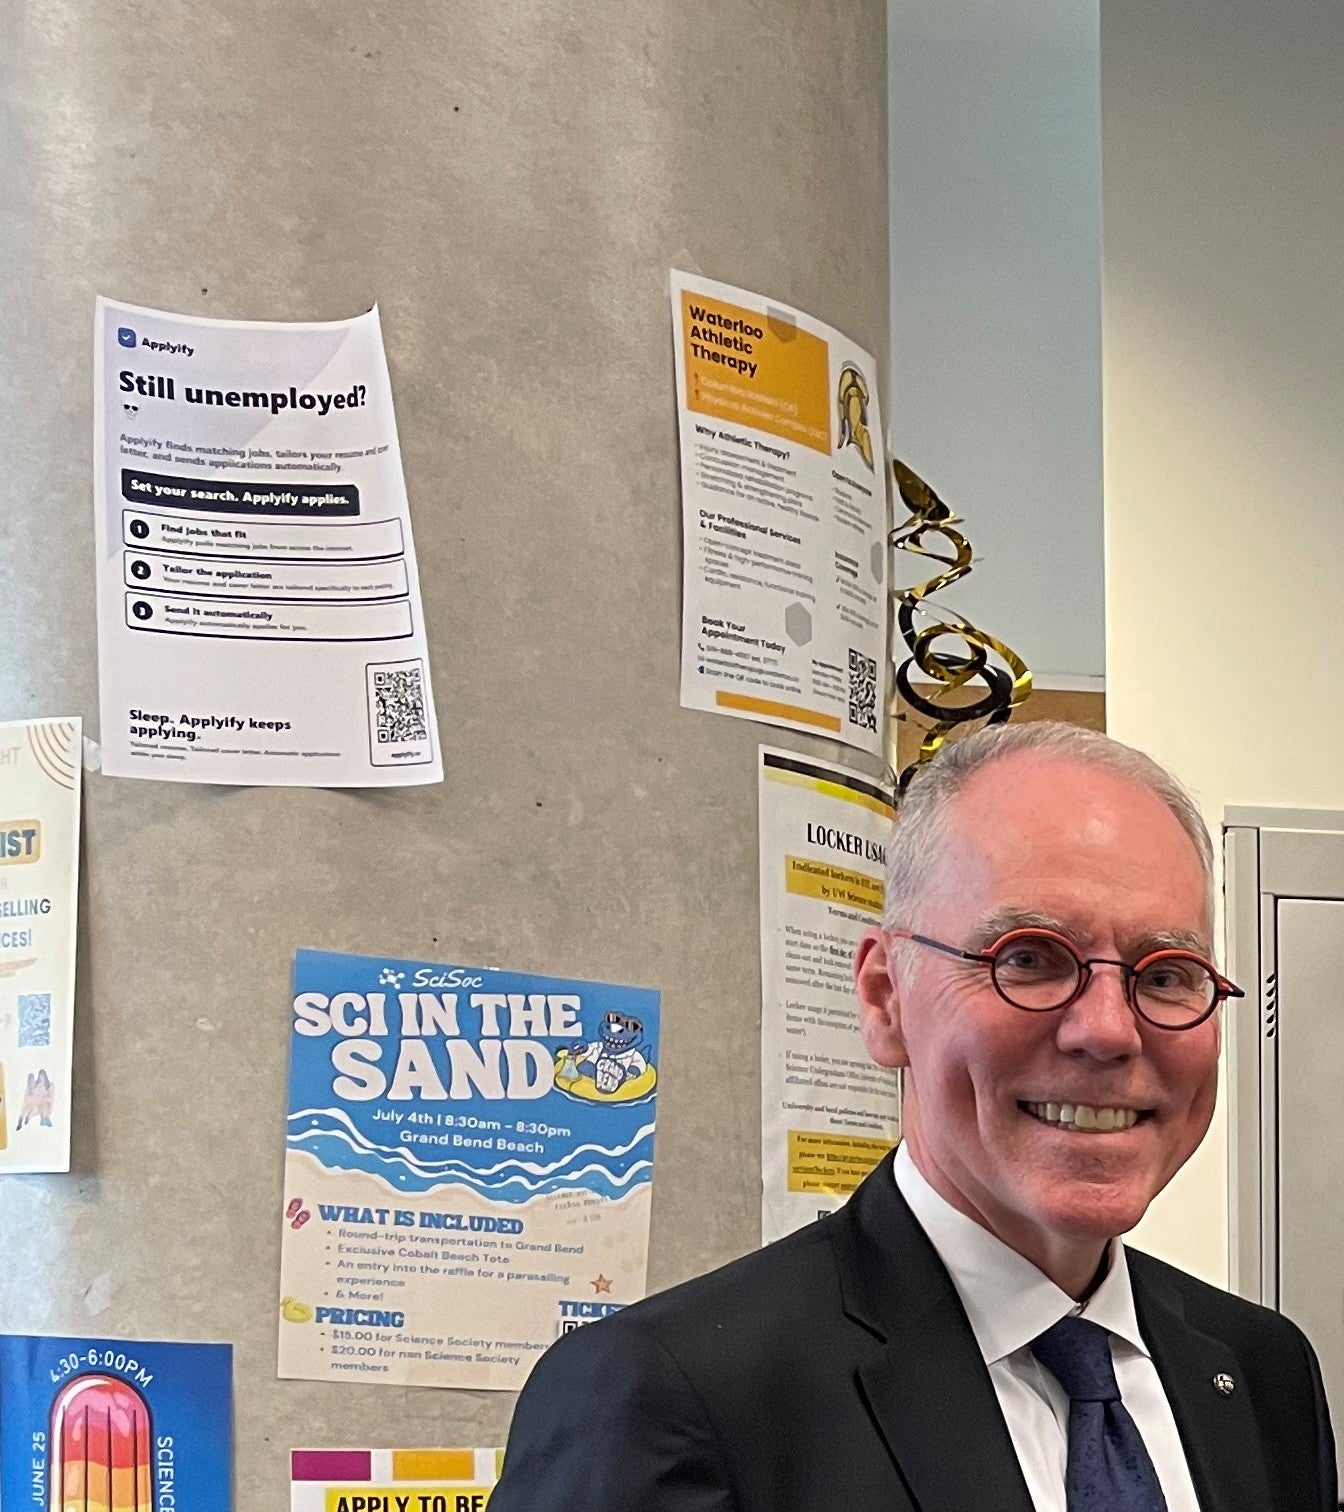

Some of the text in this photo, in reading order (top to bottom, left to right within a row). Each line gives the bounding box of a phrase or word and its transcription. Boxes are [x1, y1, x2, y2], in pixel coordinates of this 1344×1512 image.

[688, 304, 764, 340] Waterloo
[142, 337, 194, 357] Applyify
[690, 325, 754, 356] Athletic
[690, 342, 758, 379] Therapy
[119, 370, 366, 416] Still unemployed?
[195, 446, 246, 459] matching
[130, 479, 350, 507] Set your search. Applyify applies.
[161, 524, 183, 534] Find
[186, 526, 208, 536] jobs
[210, 529, 232, 538] that
[196, 568, 213, 576] the
[216, 570, 272, 580] application
[164, 604, 190, 614] Send
[203, 610, 273, 622] automatically
[702, 615, 724, 628] Book
[129, 709, 292, 732] Sleep. Applyify keeps
[130, 725, 202, 742] applying.
[807, 823, 862, 857] LOCKER
[0, 898, 51, 917] ELLING
[412, 968, 484, 989] SciSoc
[293, 992, 583, 1038] SCI IN THE
[331, 1038, 556, 1102] SAND
[372, 1108, 405, 1125] July
[407, 1111, 434, 1125] 4th
[444, 1114, 501, 1131] 8:30am
[516, 1120, 571, 1138] 8:30pm
[400, 1130, 544, 1154] Grand Bend Beach
[316, 1204, 524, 1235] WHAT IS INCLUDED
[338, 1228, 584, 1254] Round-trip transportation to Grand Bend
[338, 1245, 510, 1264] Exclusive Cobalt Beach Tote
[336, 1260, 354, 1270] An
[356, 1261, 390, 1274] entry
[392, 1262, 417, 1274] into
[420, 1264, 440, 1275] the
[442, 1266, 475, 1278] raffle
[477, 1268, 495, 1279] for
[336, 1276, 406, 1288] experience
[314, 1306, 405, 1328] PRICING
[332, 1329, 373, 1342] $15.00
[375, 1332, 392, 1342] for
[396, 1333, 444, 1346] Science
[447, 1335, 492, 1350] Society
[330, 1345, 520, 1366] $20.00 for non Science Society
[330, 1362, 389, 1373] members
[32, 1430, 46, 1453] 25
[32, 1458, 46, 1507] JUNE
